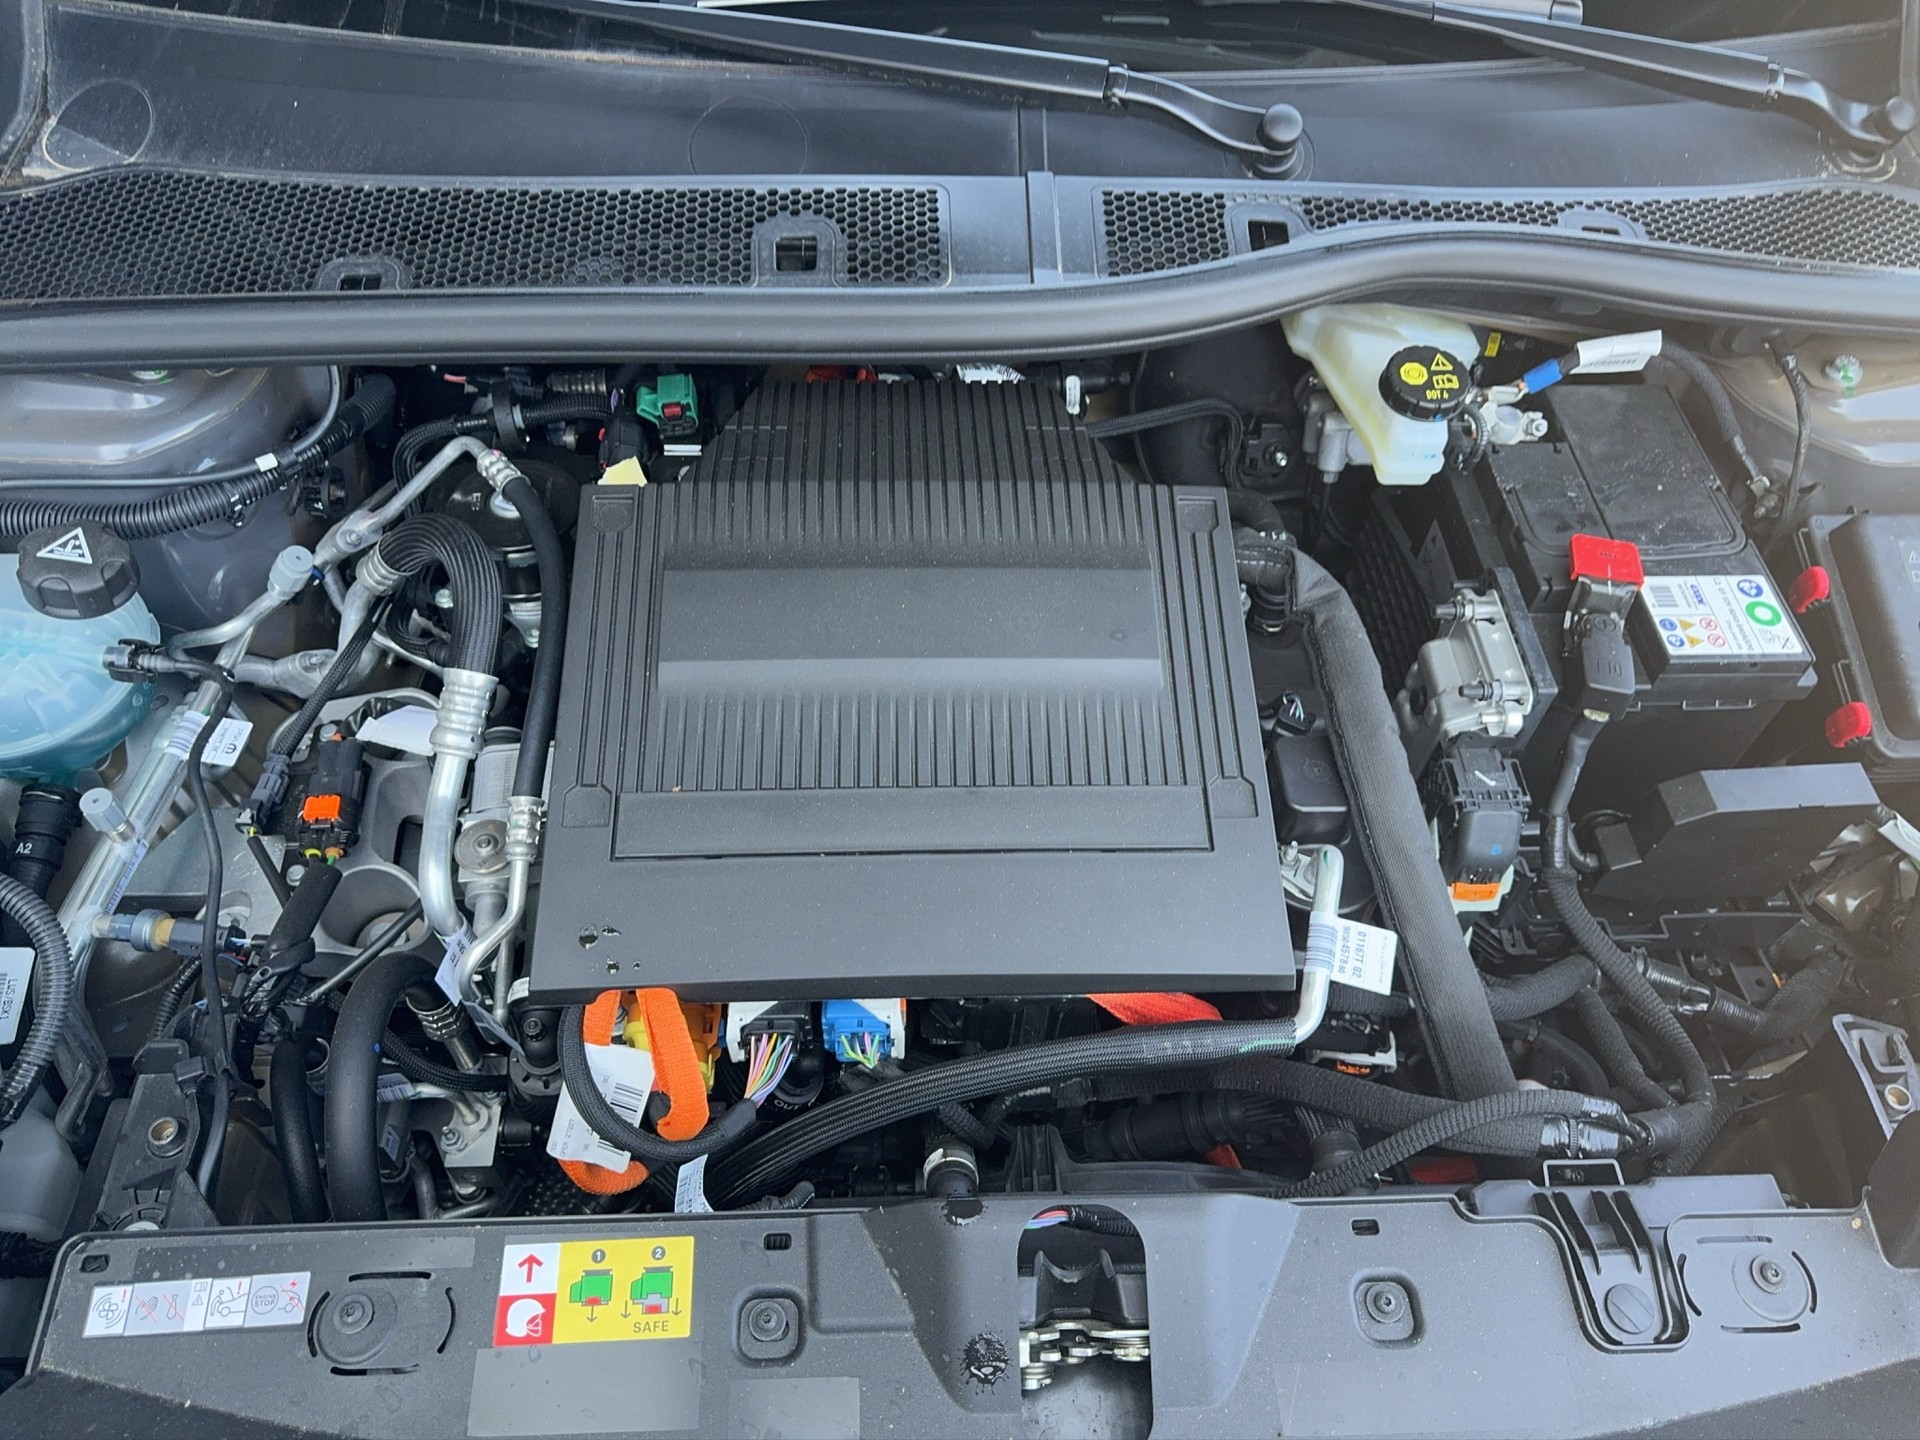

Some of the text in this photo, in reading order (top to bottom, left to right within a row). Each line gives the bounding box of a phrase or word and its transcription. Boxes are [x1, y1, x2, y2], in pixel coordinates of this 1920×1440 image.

[1426, 390, 1449, 400] DOT 4
[15, 842, 33, 854] A2
[1352, 965, 1363, 979] 02
[596, 1251, 601, 1261] 1
[655, 1248, 662, 1259] 2
[254, 1299, 276, 1307] STOP
[633, 1320, 669, 1333] SAFE
